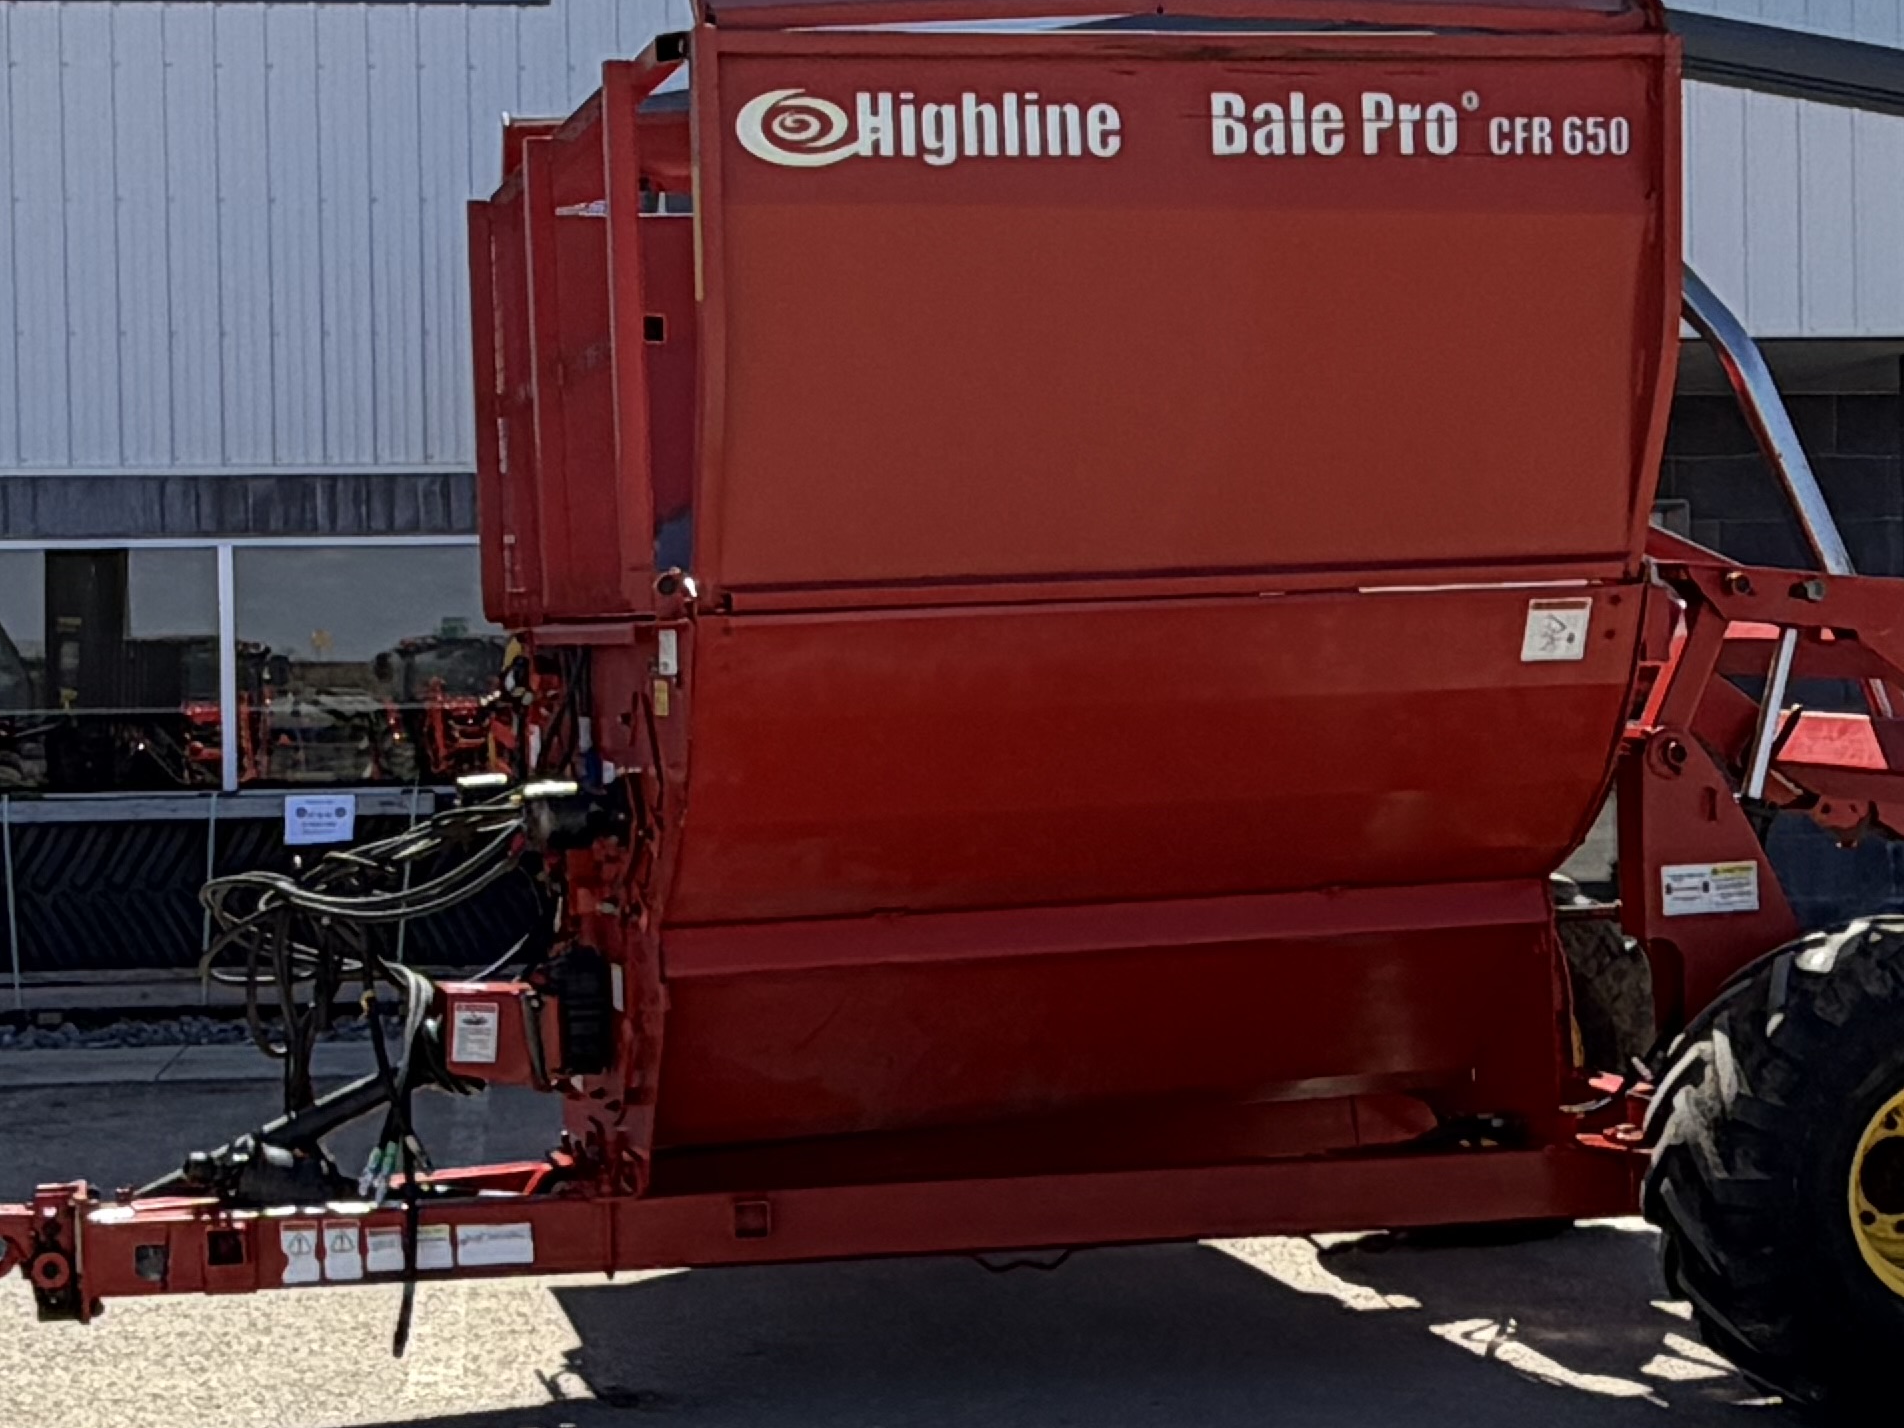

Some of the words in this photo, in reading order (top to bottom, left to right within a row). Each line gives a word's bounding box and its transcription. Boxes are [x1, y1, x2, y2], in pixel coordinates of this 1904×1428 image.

[855, 91, 1121, 166] Highline
[1210, 91, 1345, 156] Bale
[1488, 115, 1553, 156] CFR
[1561, 115, 1630, 156] 650
